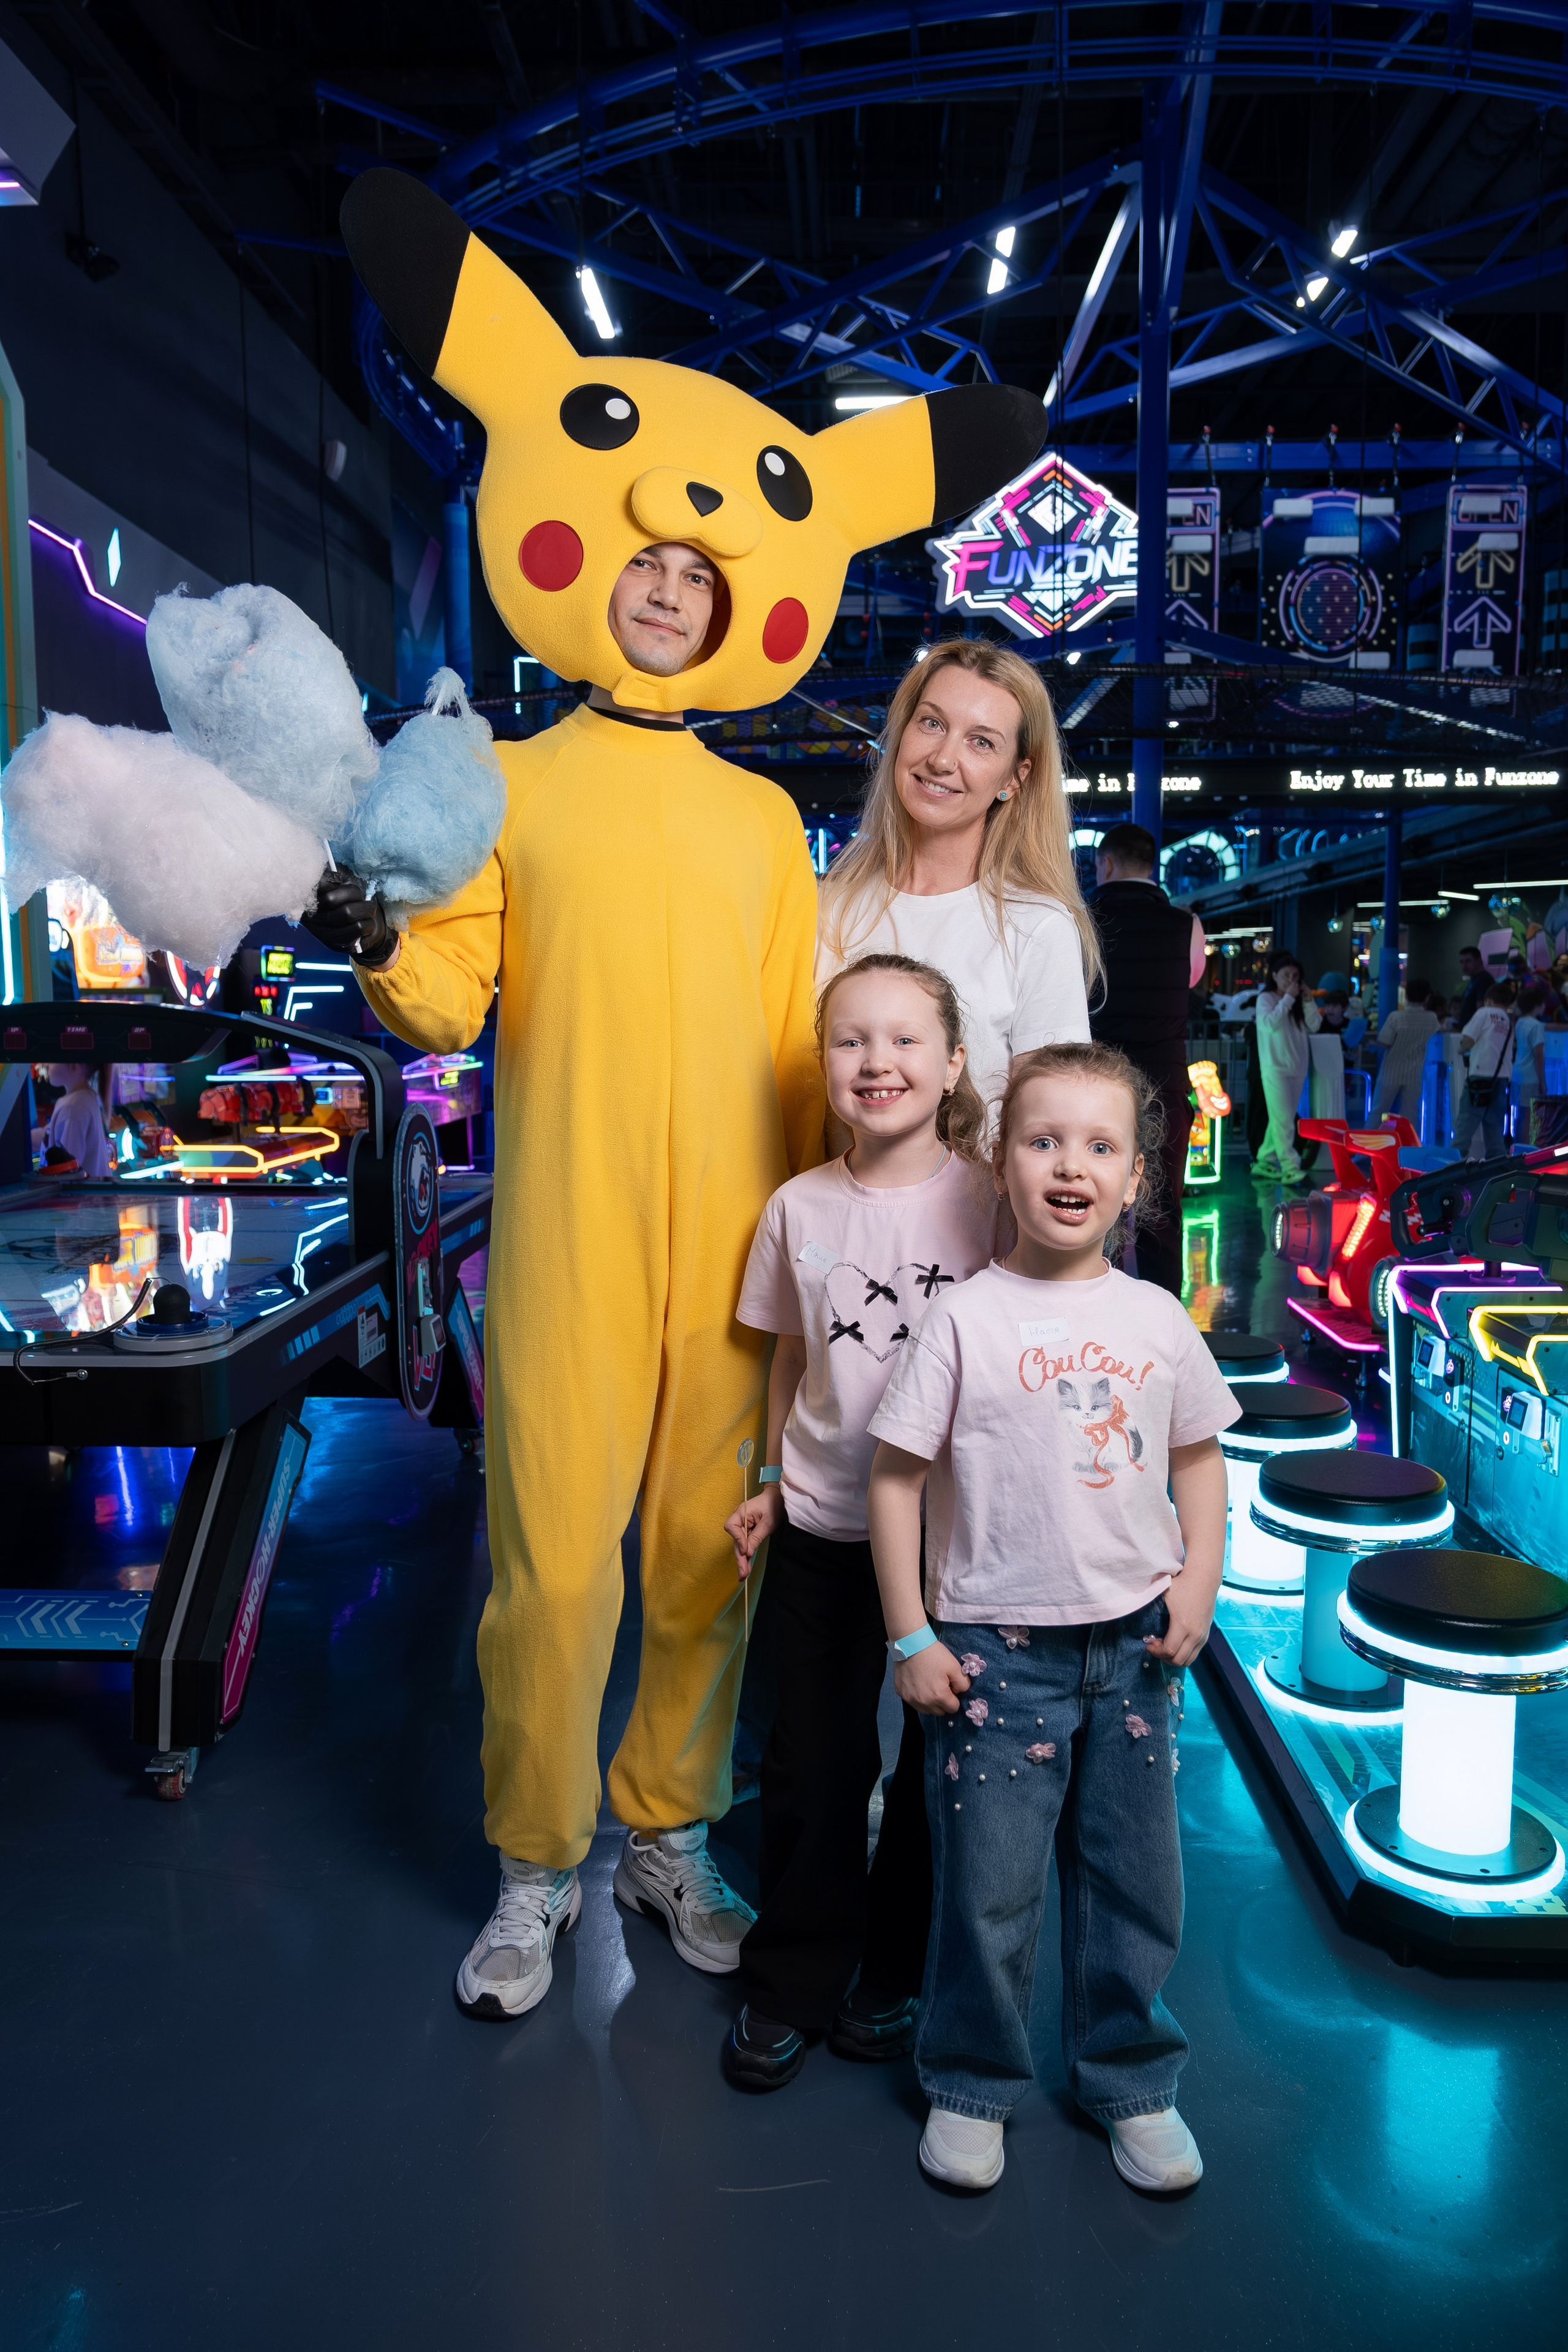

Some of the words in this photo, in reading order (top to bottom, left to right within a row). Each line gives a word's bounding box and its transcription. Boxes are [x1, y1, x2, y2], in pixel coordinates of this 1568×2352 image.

[951, 540, 1138, 595] FUNZONE
[1061, 773, 1090, 793] ime
[1098, 772, 1121, 792] in
[1126, 772, 1202, 792] Fzone
[1290, 770, 1344, 791] Enjoy
[1352, 769, 1395, 789] Your
[1403, 767, 1447, 787] Time
[1455, 767, 1478, 786] in
[1485, 767, 1560, 786] Funzone
